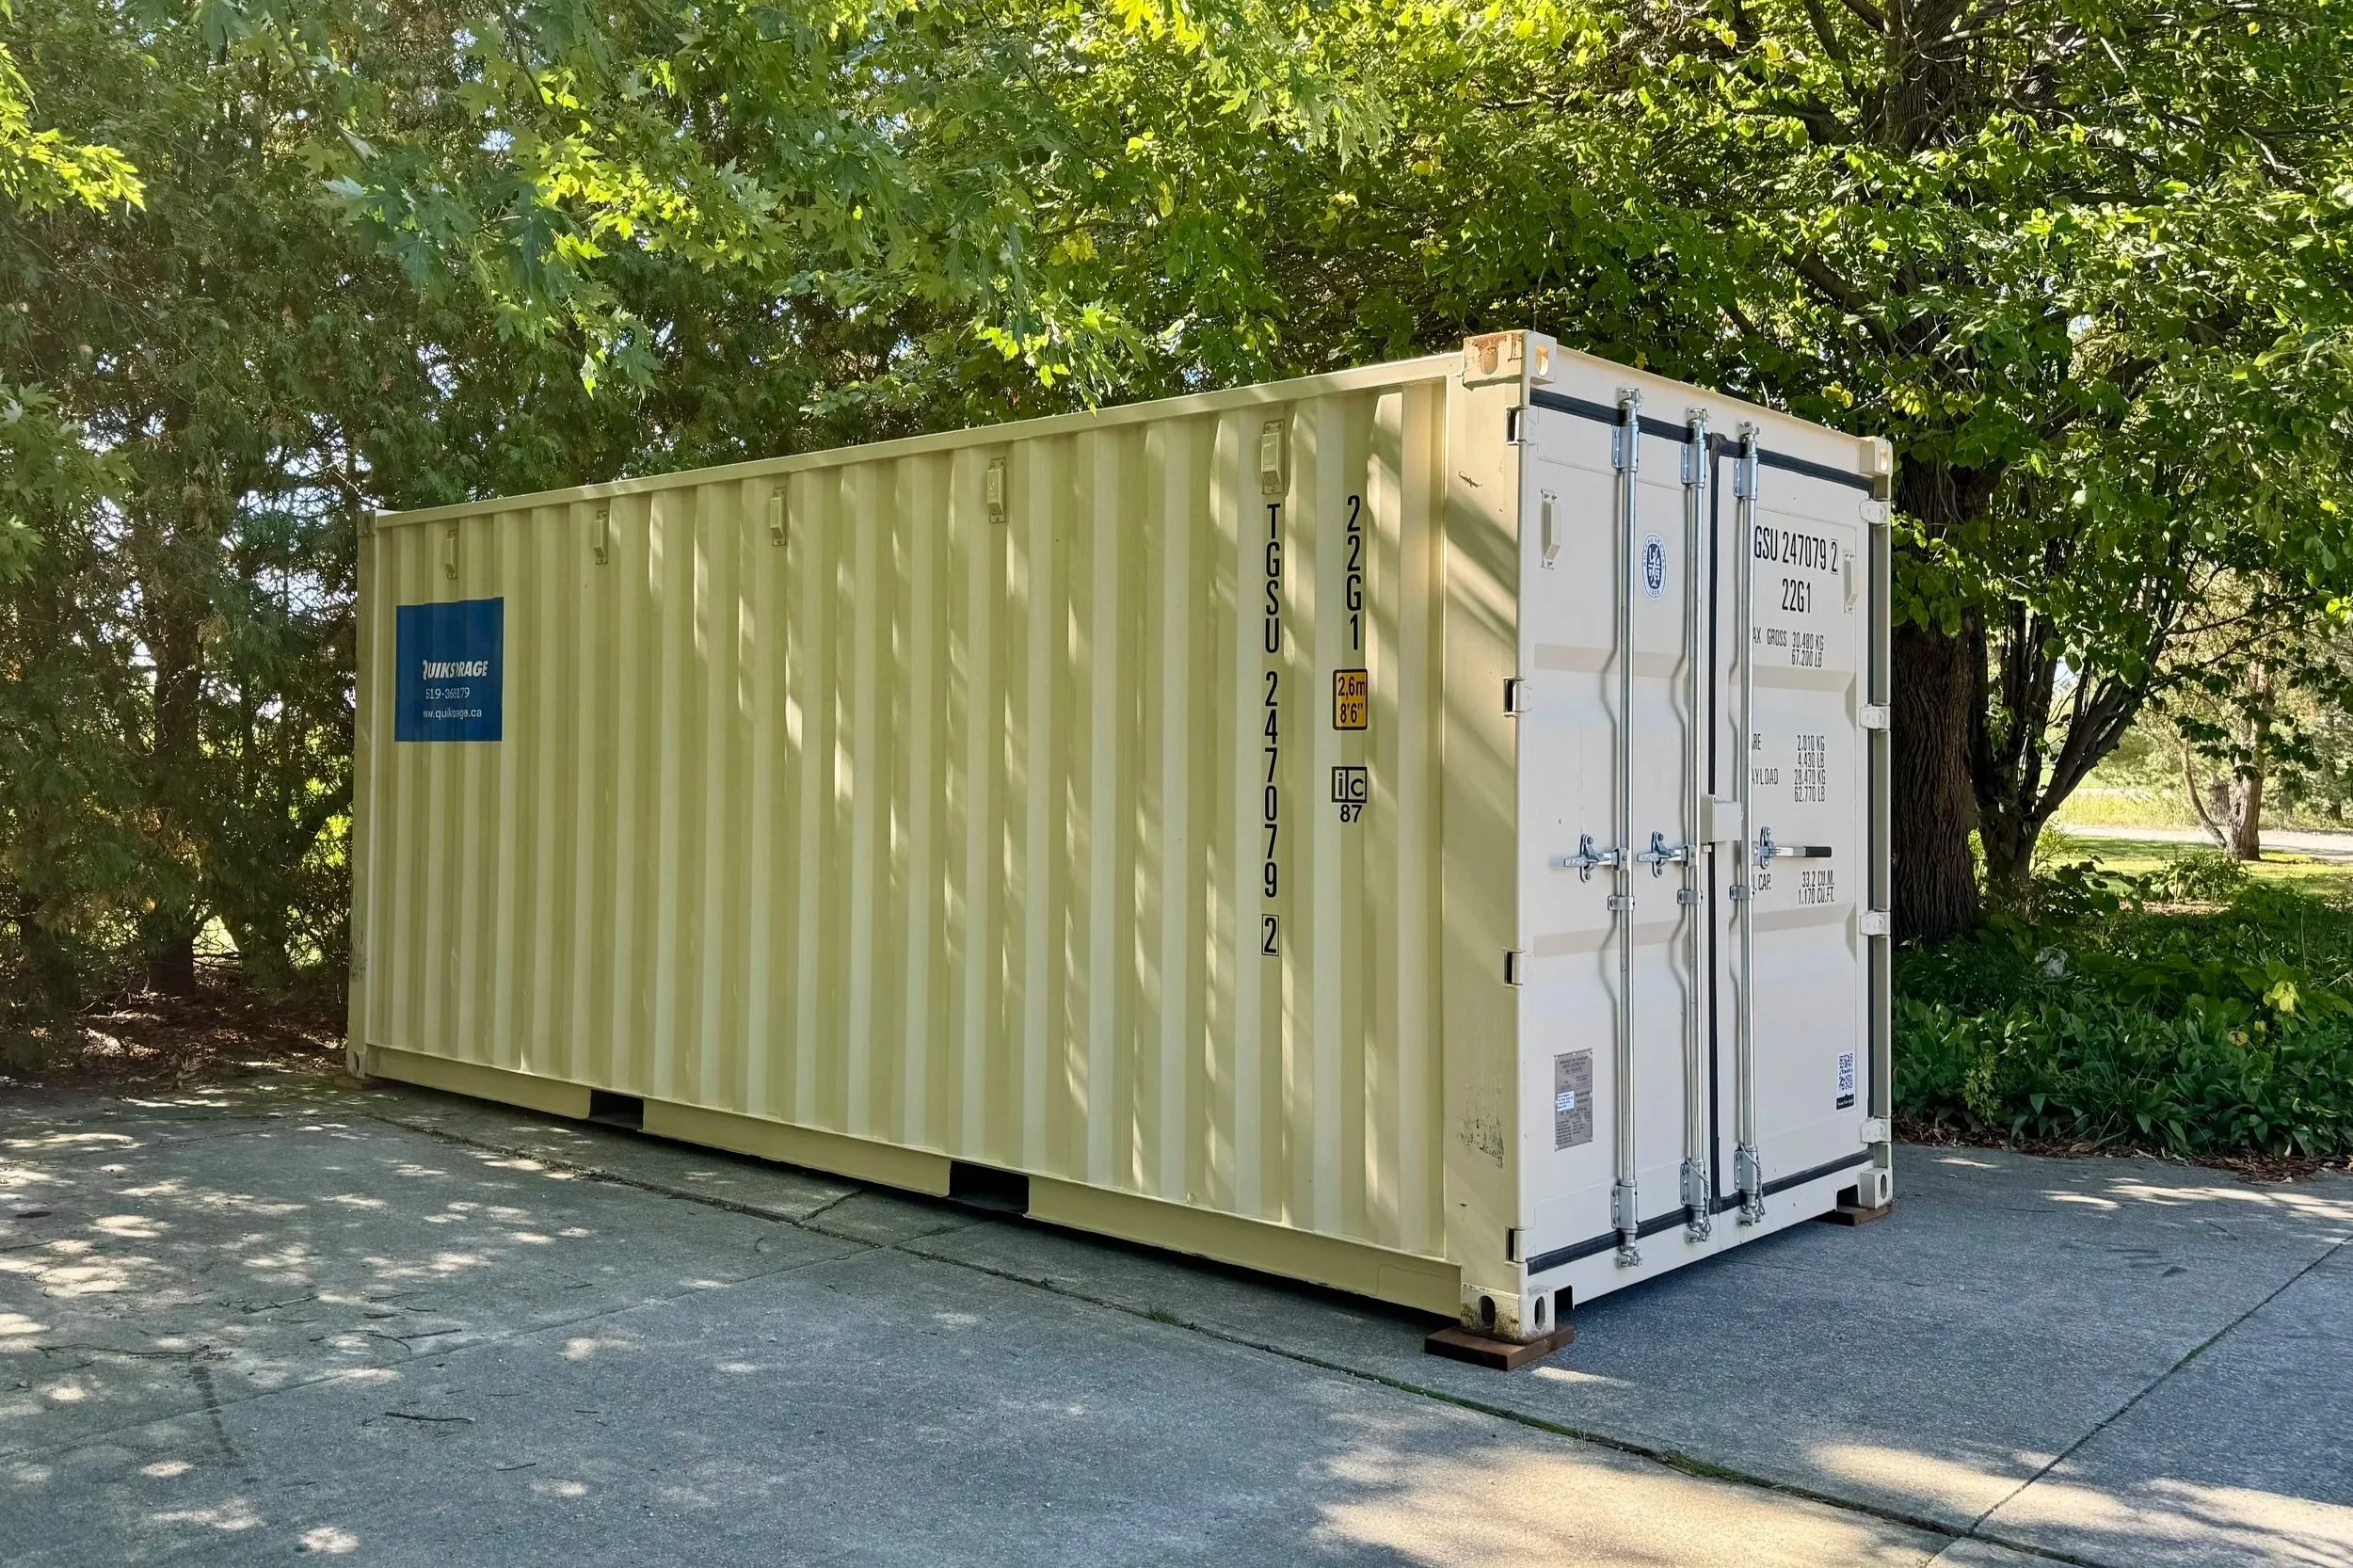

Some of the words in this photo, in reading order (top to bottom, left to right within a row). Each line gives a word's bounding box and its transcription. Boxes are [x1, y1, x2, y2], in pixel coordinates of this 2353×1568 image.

[1754, 525, 1778, 561] GSU
[1782, 531, 1827, 570] 247079
[1265, 504, 1281, 653] TGSU
[1347, 495, 1362, 650] 22G1
[1782, 578, 1811, 613] 22G1
[1753, 626, 1762, 644] AX
[1767, 628, 1787, 647] GROSS
[1791, 632, 1814, 650] 30.480
[1815, 634, 1824, 651] KG
[1791, 648, 1813, 667] 67.200
[1815, 651, 1822, 668] LB
[1337, 676, 1365, 700] 2,6m
[1797, 735, 1815, 751] 2.010
[1817, 735, 1825, 751] KG
[1797, 752, 1815, 768] 4.430
[1817, 752, 1825, 768] LB
[1264, 671, 1278, 898] 247079
[1752, 768, 1779, 785] AYLOAD
[1794, 769, 1816, 785] 28.470
[1817, 769, 1826, 785] KG
[1794, 786, 1816, 802] 62.770
[1817, 786, 1826, 802] LB
[1339, 804, 1363, 823] 87
[1758, 873, 1771, 890] CAP.
[1801, 871, 1816, 888] 33.2
[1799, 888, 1816, 905] 1.170
[1264, 917, 1277, 953] 2
